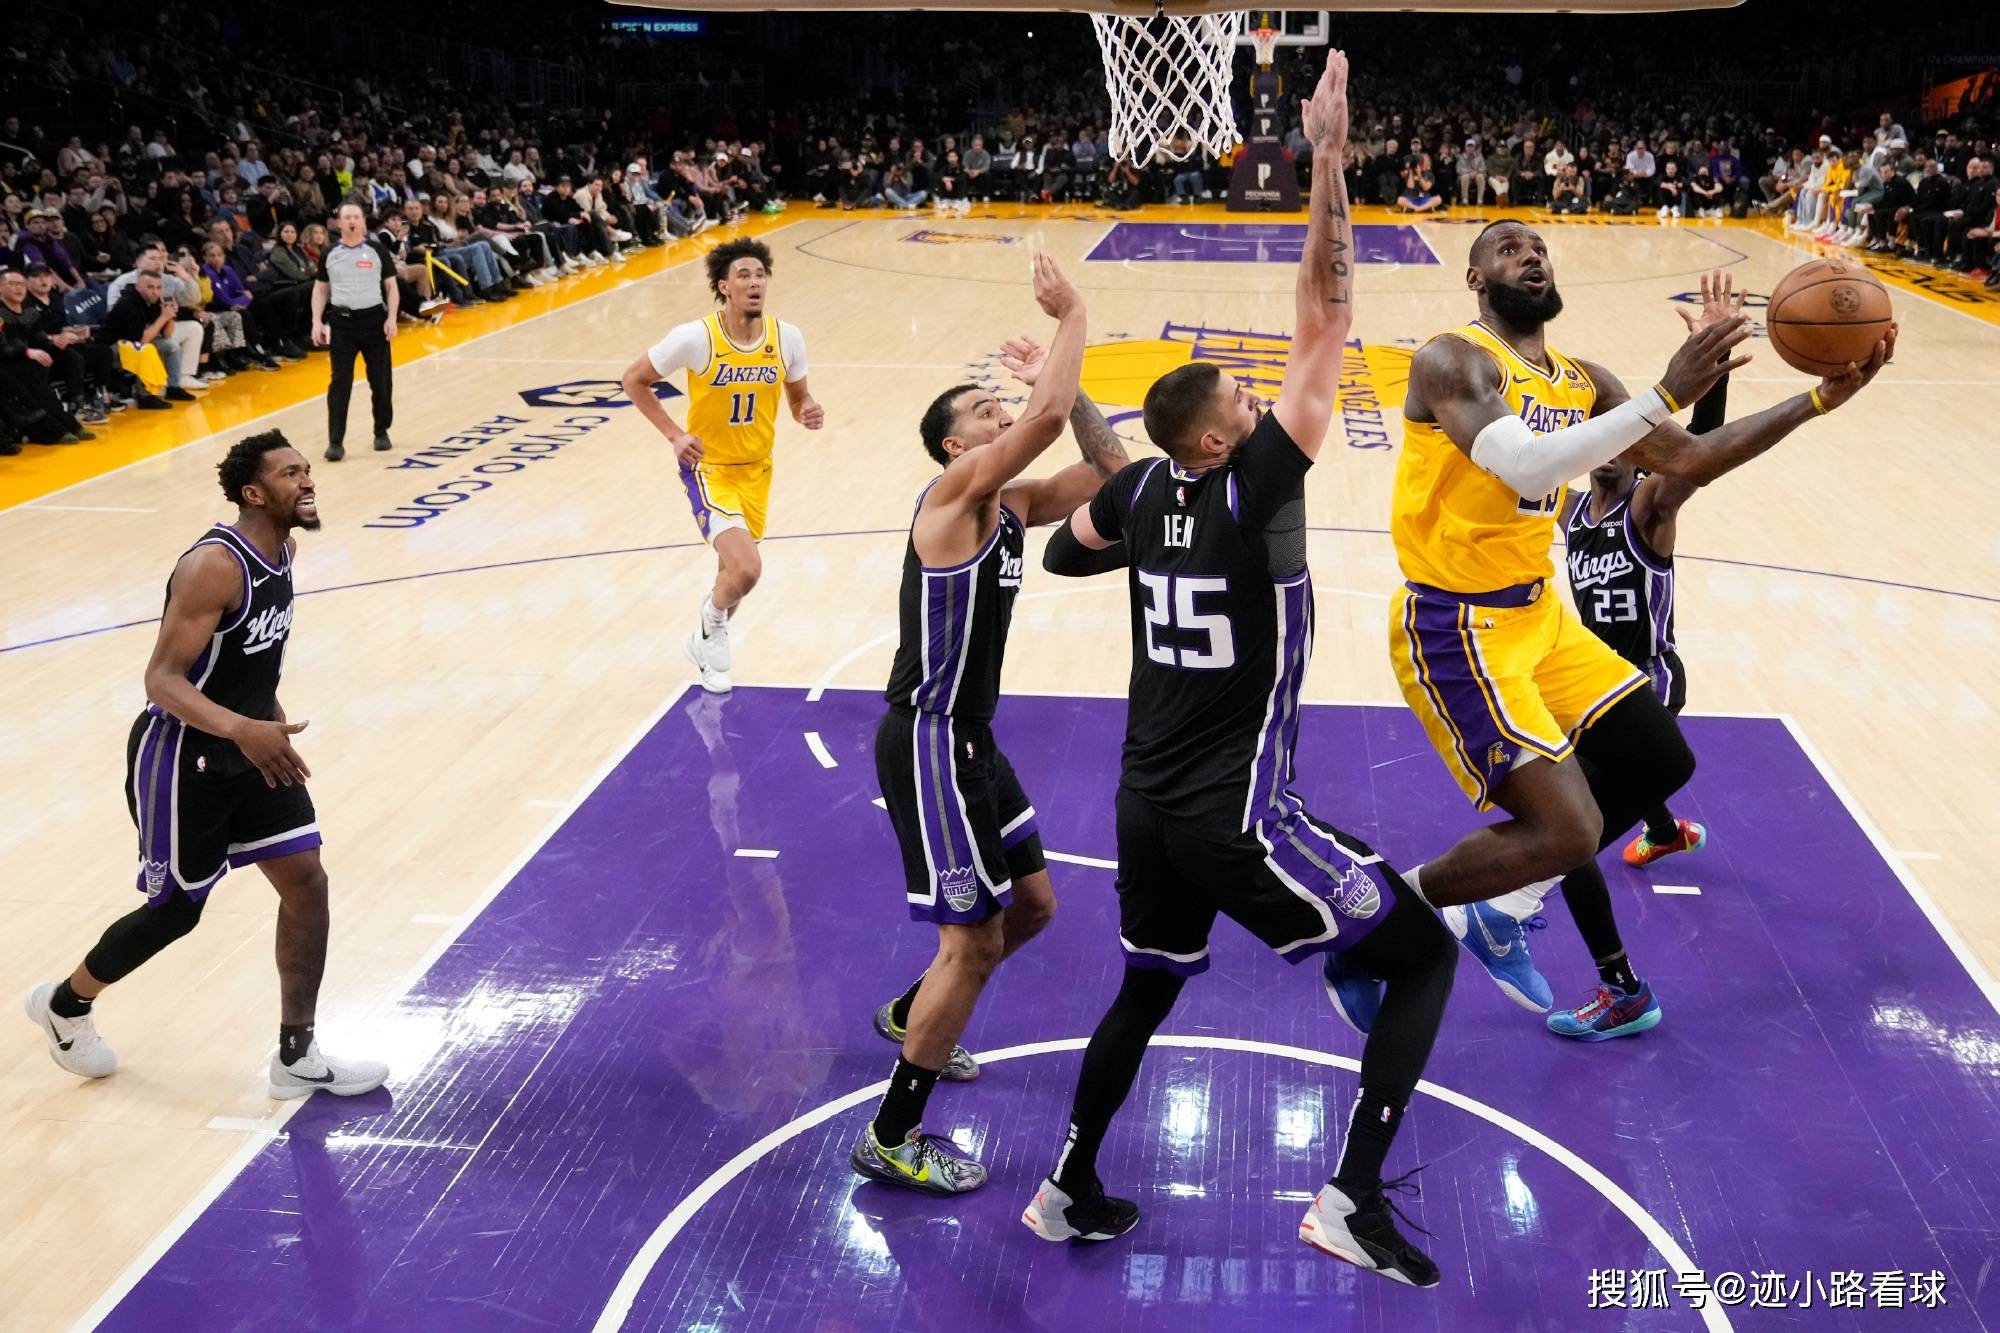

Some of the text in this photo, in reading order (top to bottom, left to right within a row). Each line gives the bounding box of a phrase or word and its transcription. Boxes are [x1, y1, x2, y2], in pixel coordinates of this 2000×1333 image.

[653, 22, 699, 32] EXPRESS
[709, 363, 778, 388] LAKERS
[728, 392, 756, 426] 11
[386, 414, 532, 470] ARENA
[1163, 514, 1196, 549] LEN
[1568, 549, 1635, 590] Kings
[1138, 569, 1237, 669] 25
[1592, 588, 1639, 624] 23
